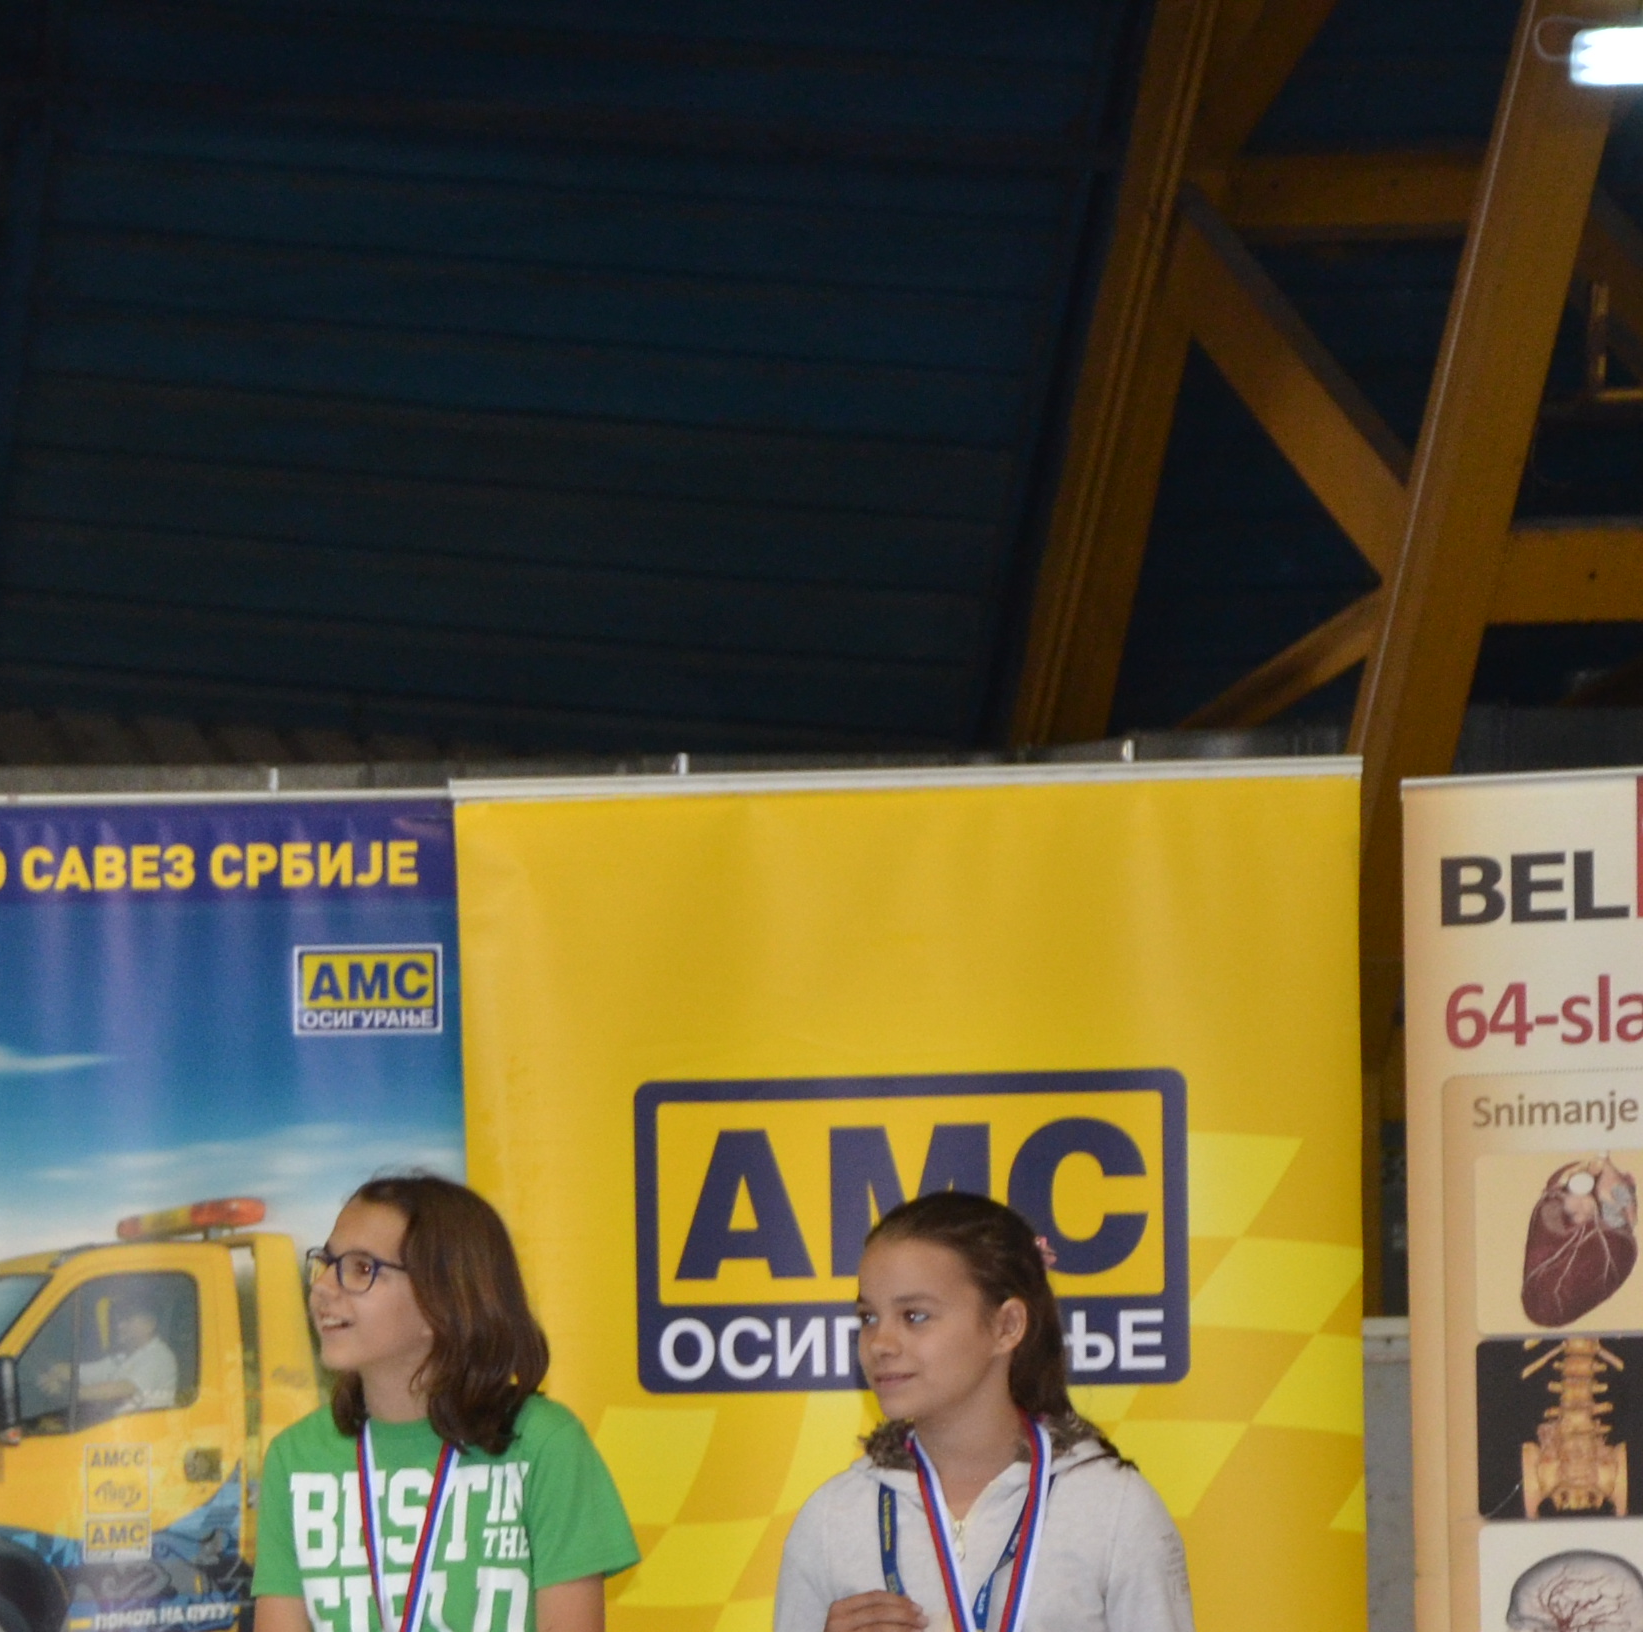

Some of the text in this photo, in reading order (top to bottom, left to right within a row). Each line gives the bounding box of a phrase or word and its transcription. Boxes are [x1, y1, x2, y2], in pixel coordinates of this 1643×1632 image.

[20, 842, 195, 891] САВЕЗ
[213, 840, 418, 889] СРБИЈЕ
[307, 958, 429, 1003] АМС
[302, 1007, 435, 1030] ОСИГУРАЊЕ
[1472, 1090, 1639, 1132] Snimanje
[660, 1309, 1165, 1383] ОСИГЊЕ
[486, 1461, 530, 1523] IN
[91, 1525, 145, 1544] АМС
[290, 1467, 489, 1569] BEST
